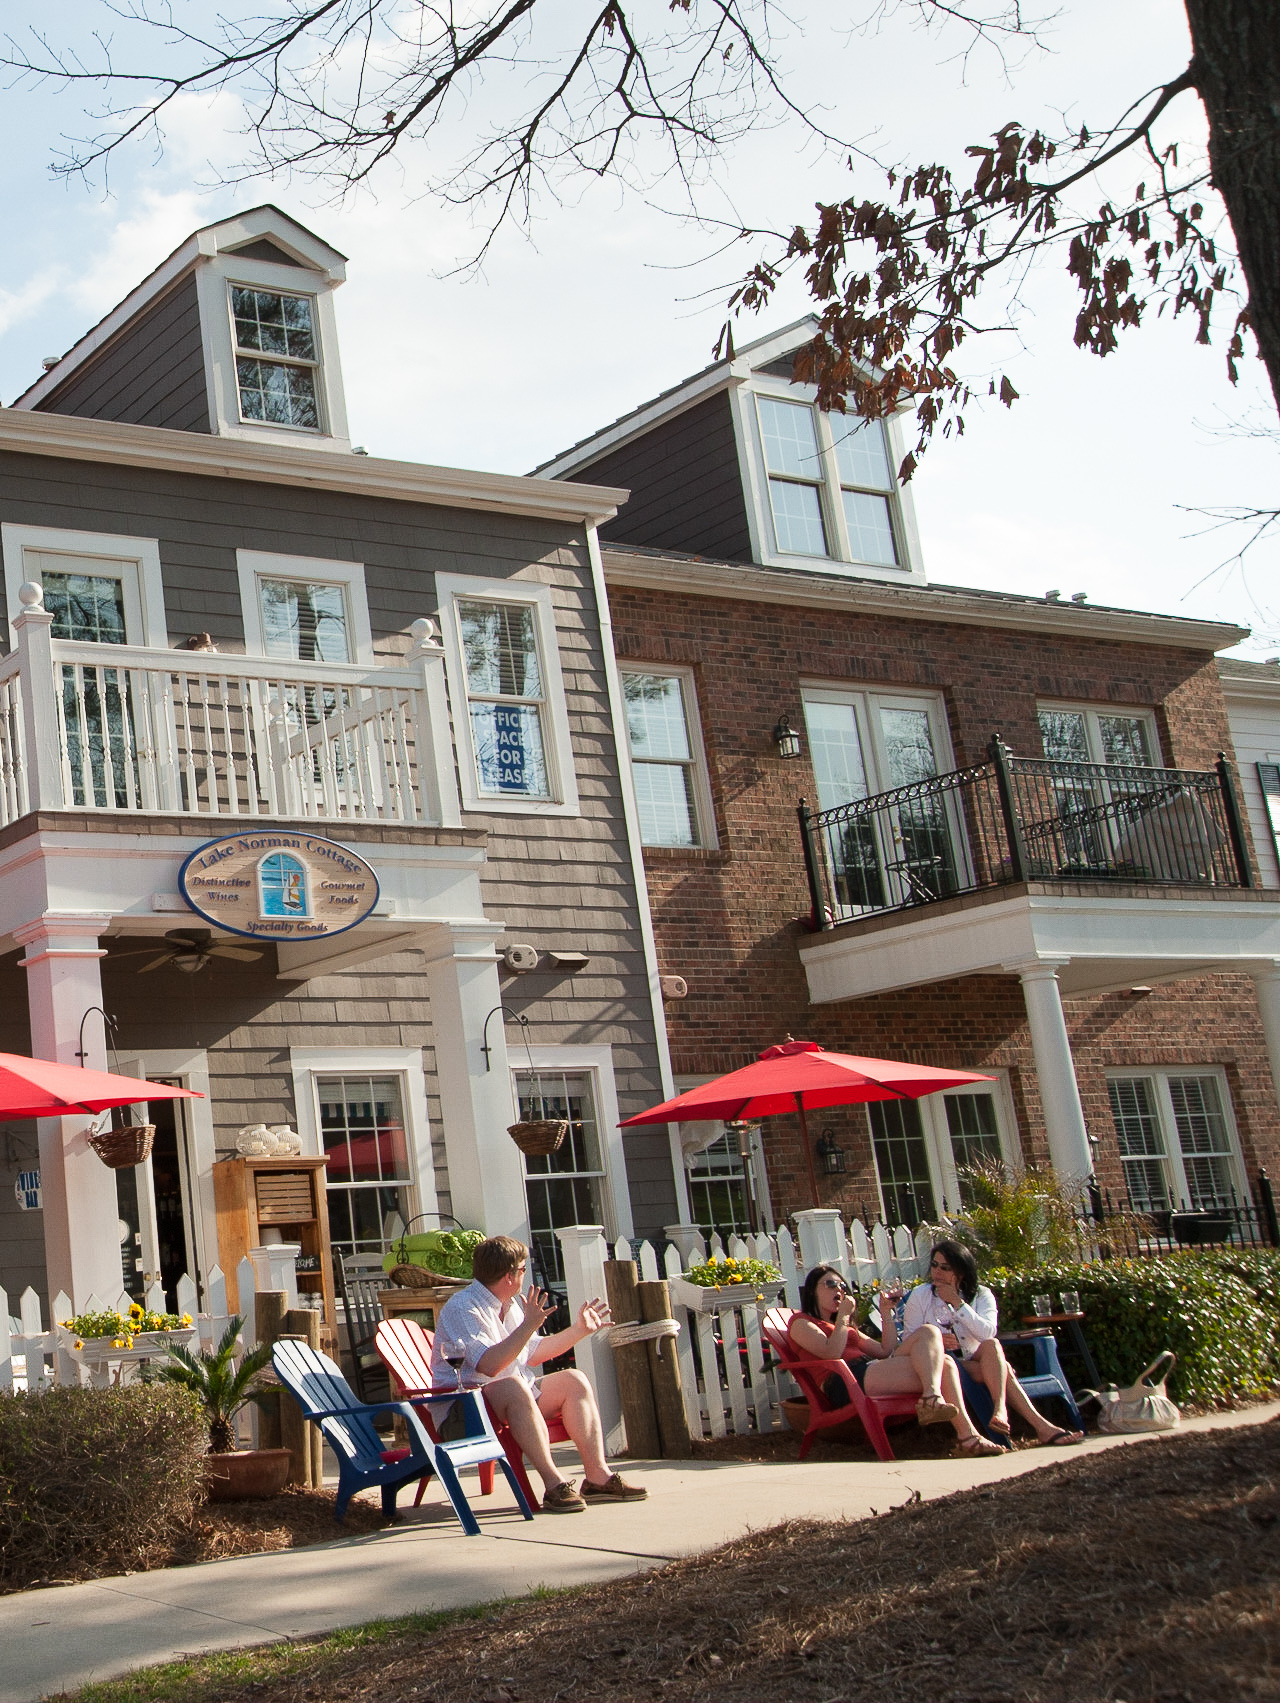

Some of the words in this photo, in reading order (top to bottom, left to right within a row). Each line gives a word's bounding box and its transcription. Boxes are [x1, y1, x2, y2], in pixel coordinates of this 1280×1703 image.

[197, 843, 234, 869] Lake
[237, 837, 301, 852] Norman
[306, 839, 362, 874] Cottage
[192, 876, 252, 888] Distinctive
[320, 881, 366, 891] Gourmet
[208, 891, 240, 902] Wines
[328, 894, 360, 905] Foods
[246, 921, 294, 934] Specialty
[296, 922, 329, 932] Goods
